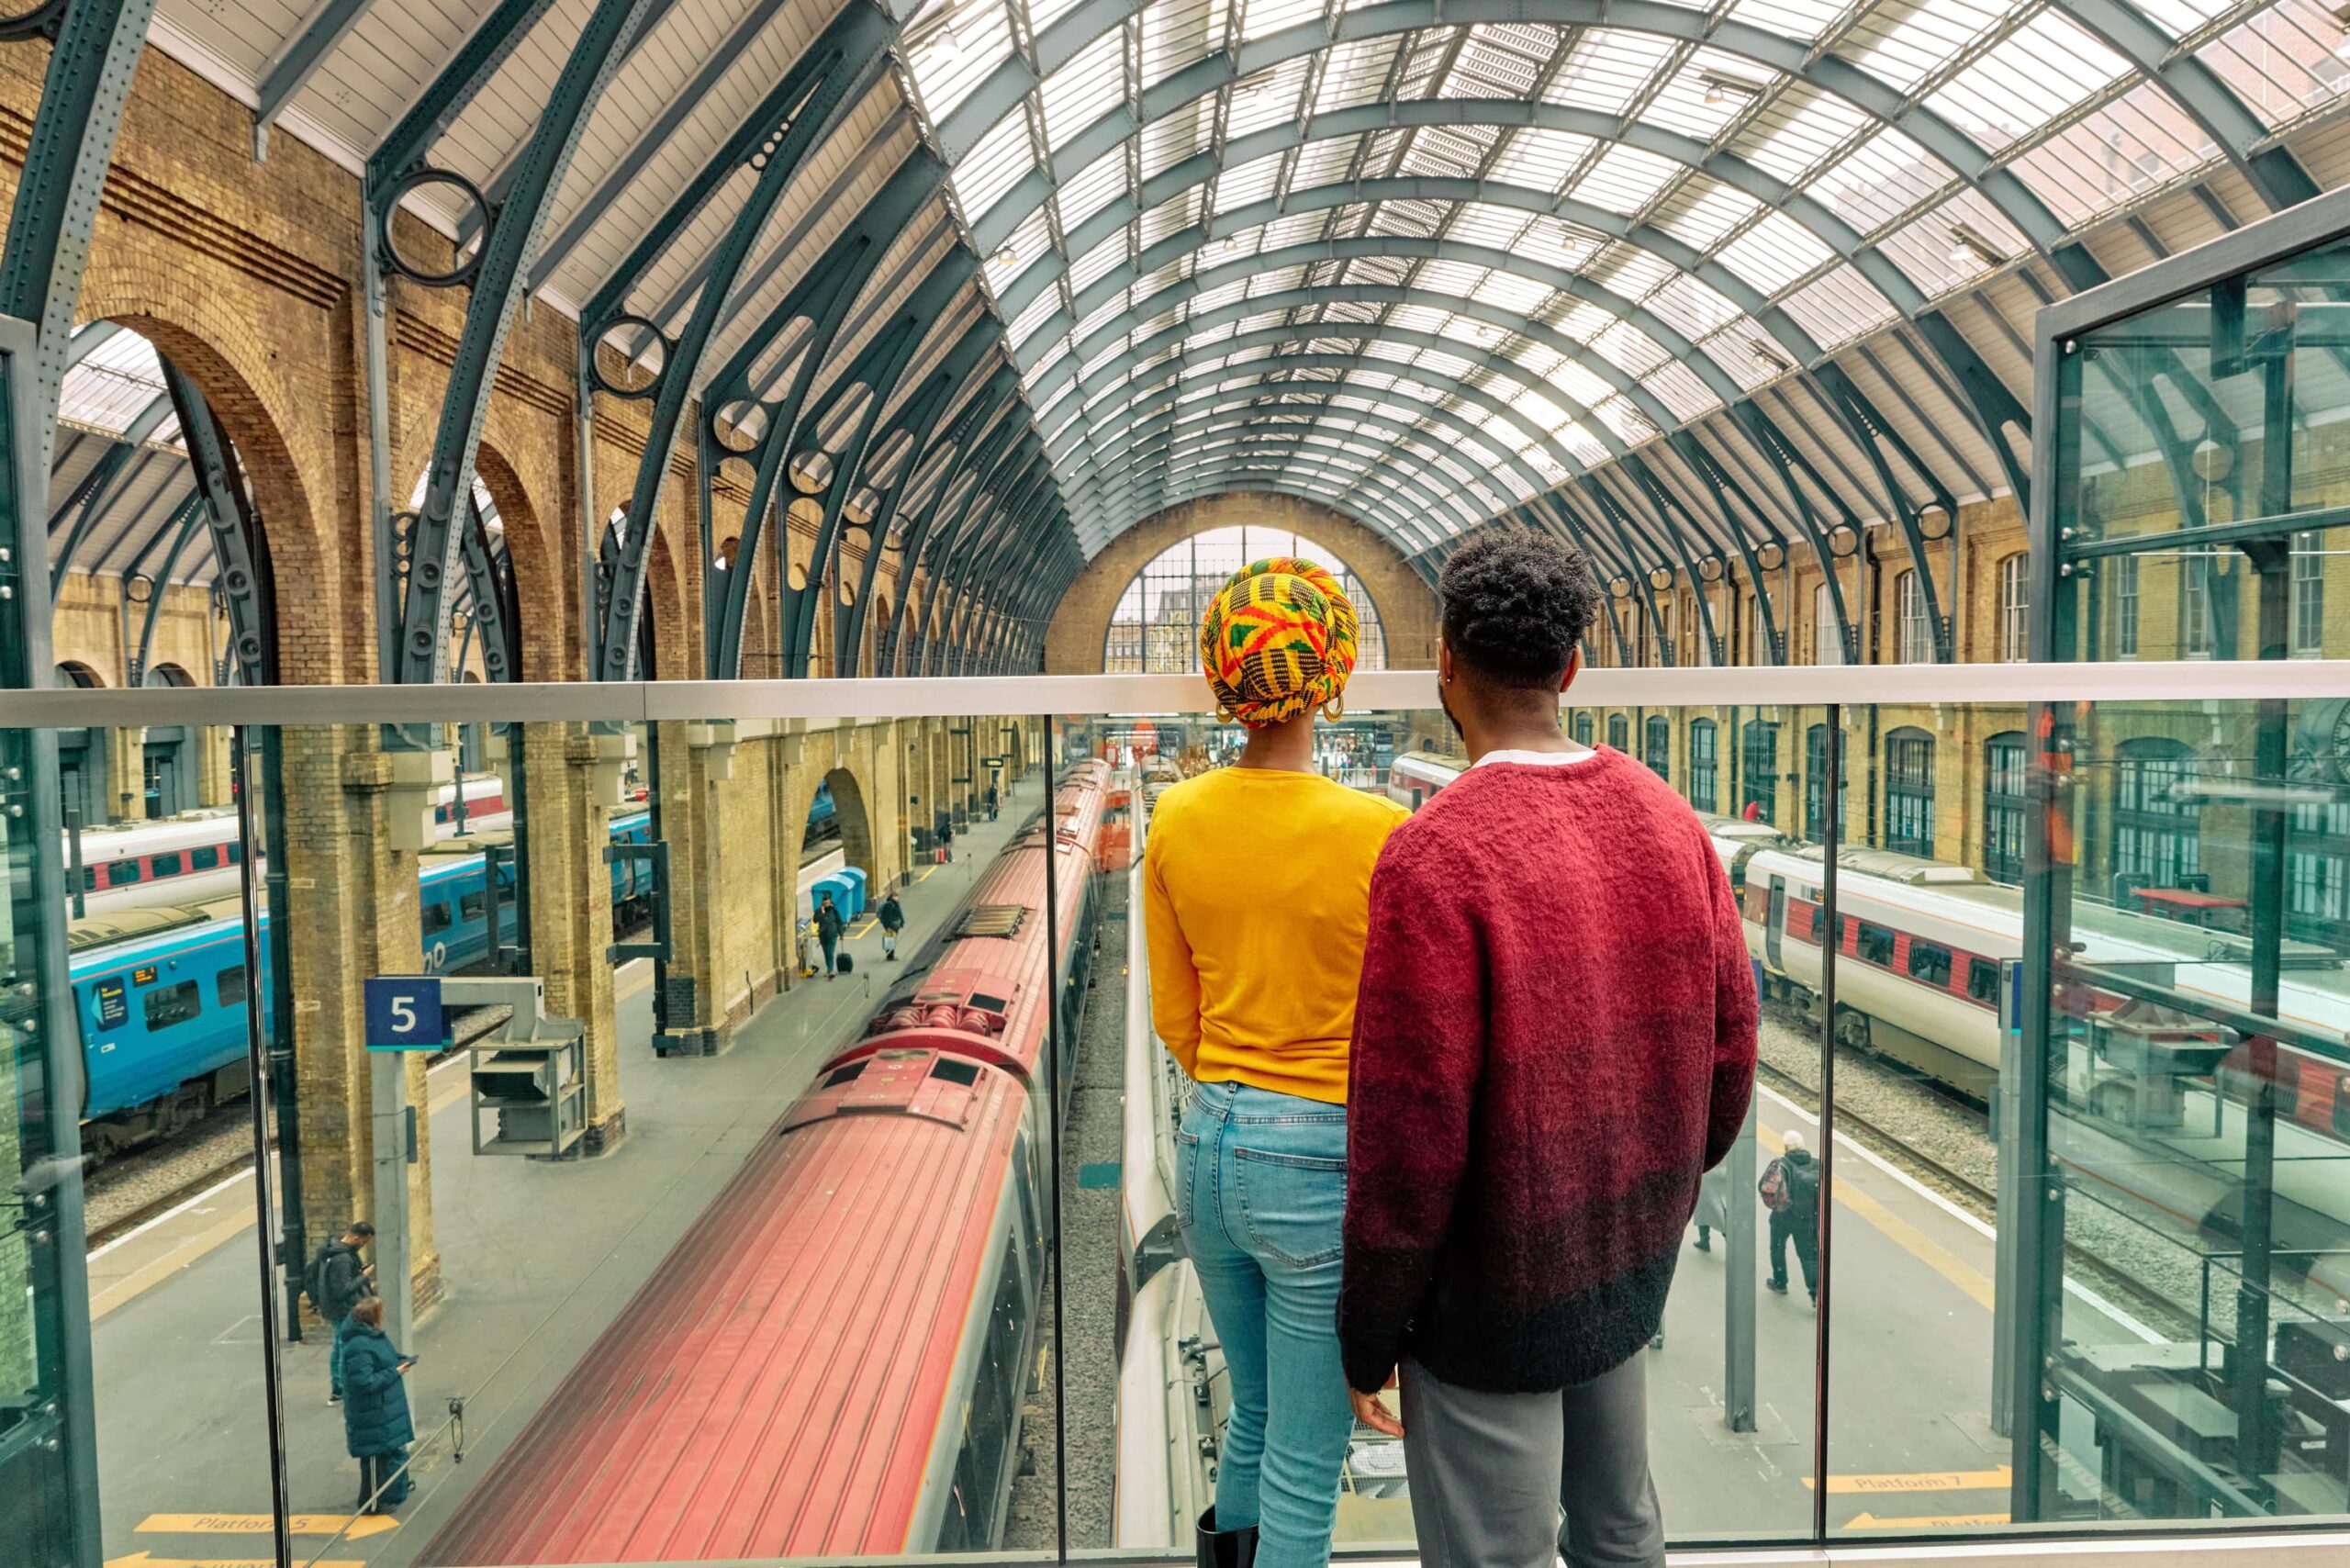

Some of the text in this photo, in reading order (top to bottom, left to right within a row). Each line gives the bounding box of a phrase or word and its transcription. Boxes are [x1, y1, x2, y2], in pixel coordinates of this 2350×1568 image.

[391, 996, 417, 1033] 5
[1854, 1475, 1961, 1488] Platform 7
[193, 1517, 310, 1530] Platfor 5
